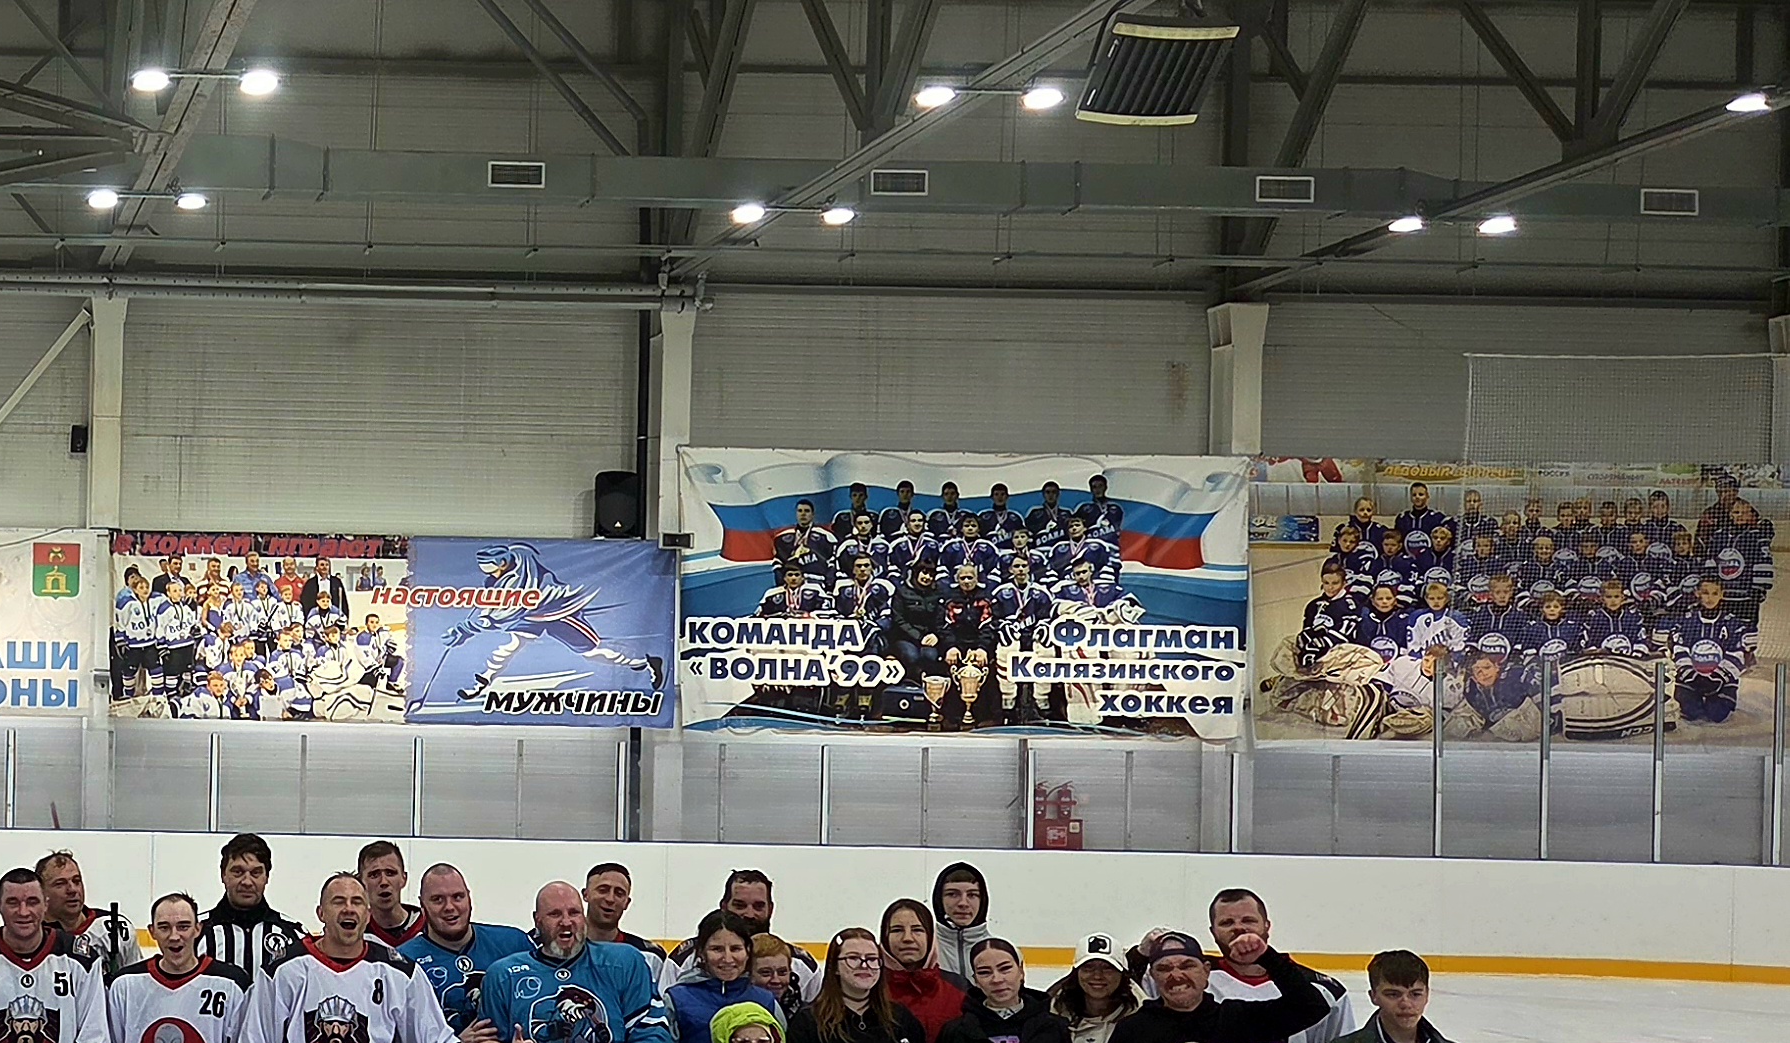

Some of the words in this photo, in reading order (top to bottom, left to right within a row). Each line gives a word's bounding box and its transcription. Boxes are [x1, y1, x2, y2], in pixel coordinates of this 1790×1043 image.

[372, 585, 541, 611] настоящие
[688, 621, 860, 648] КОМАНДА
[1054, 621, 1235, 652] Флагман
[1011, 656, 1235, 682] Калязинского
[484, 687, 662, 716] мужчины
[1099, 691, 1234, 715] хоккея
[199, 990, 226, 1018] 26
[372, 979, 384, 1005] 8
